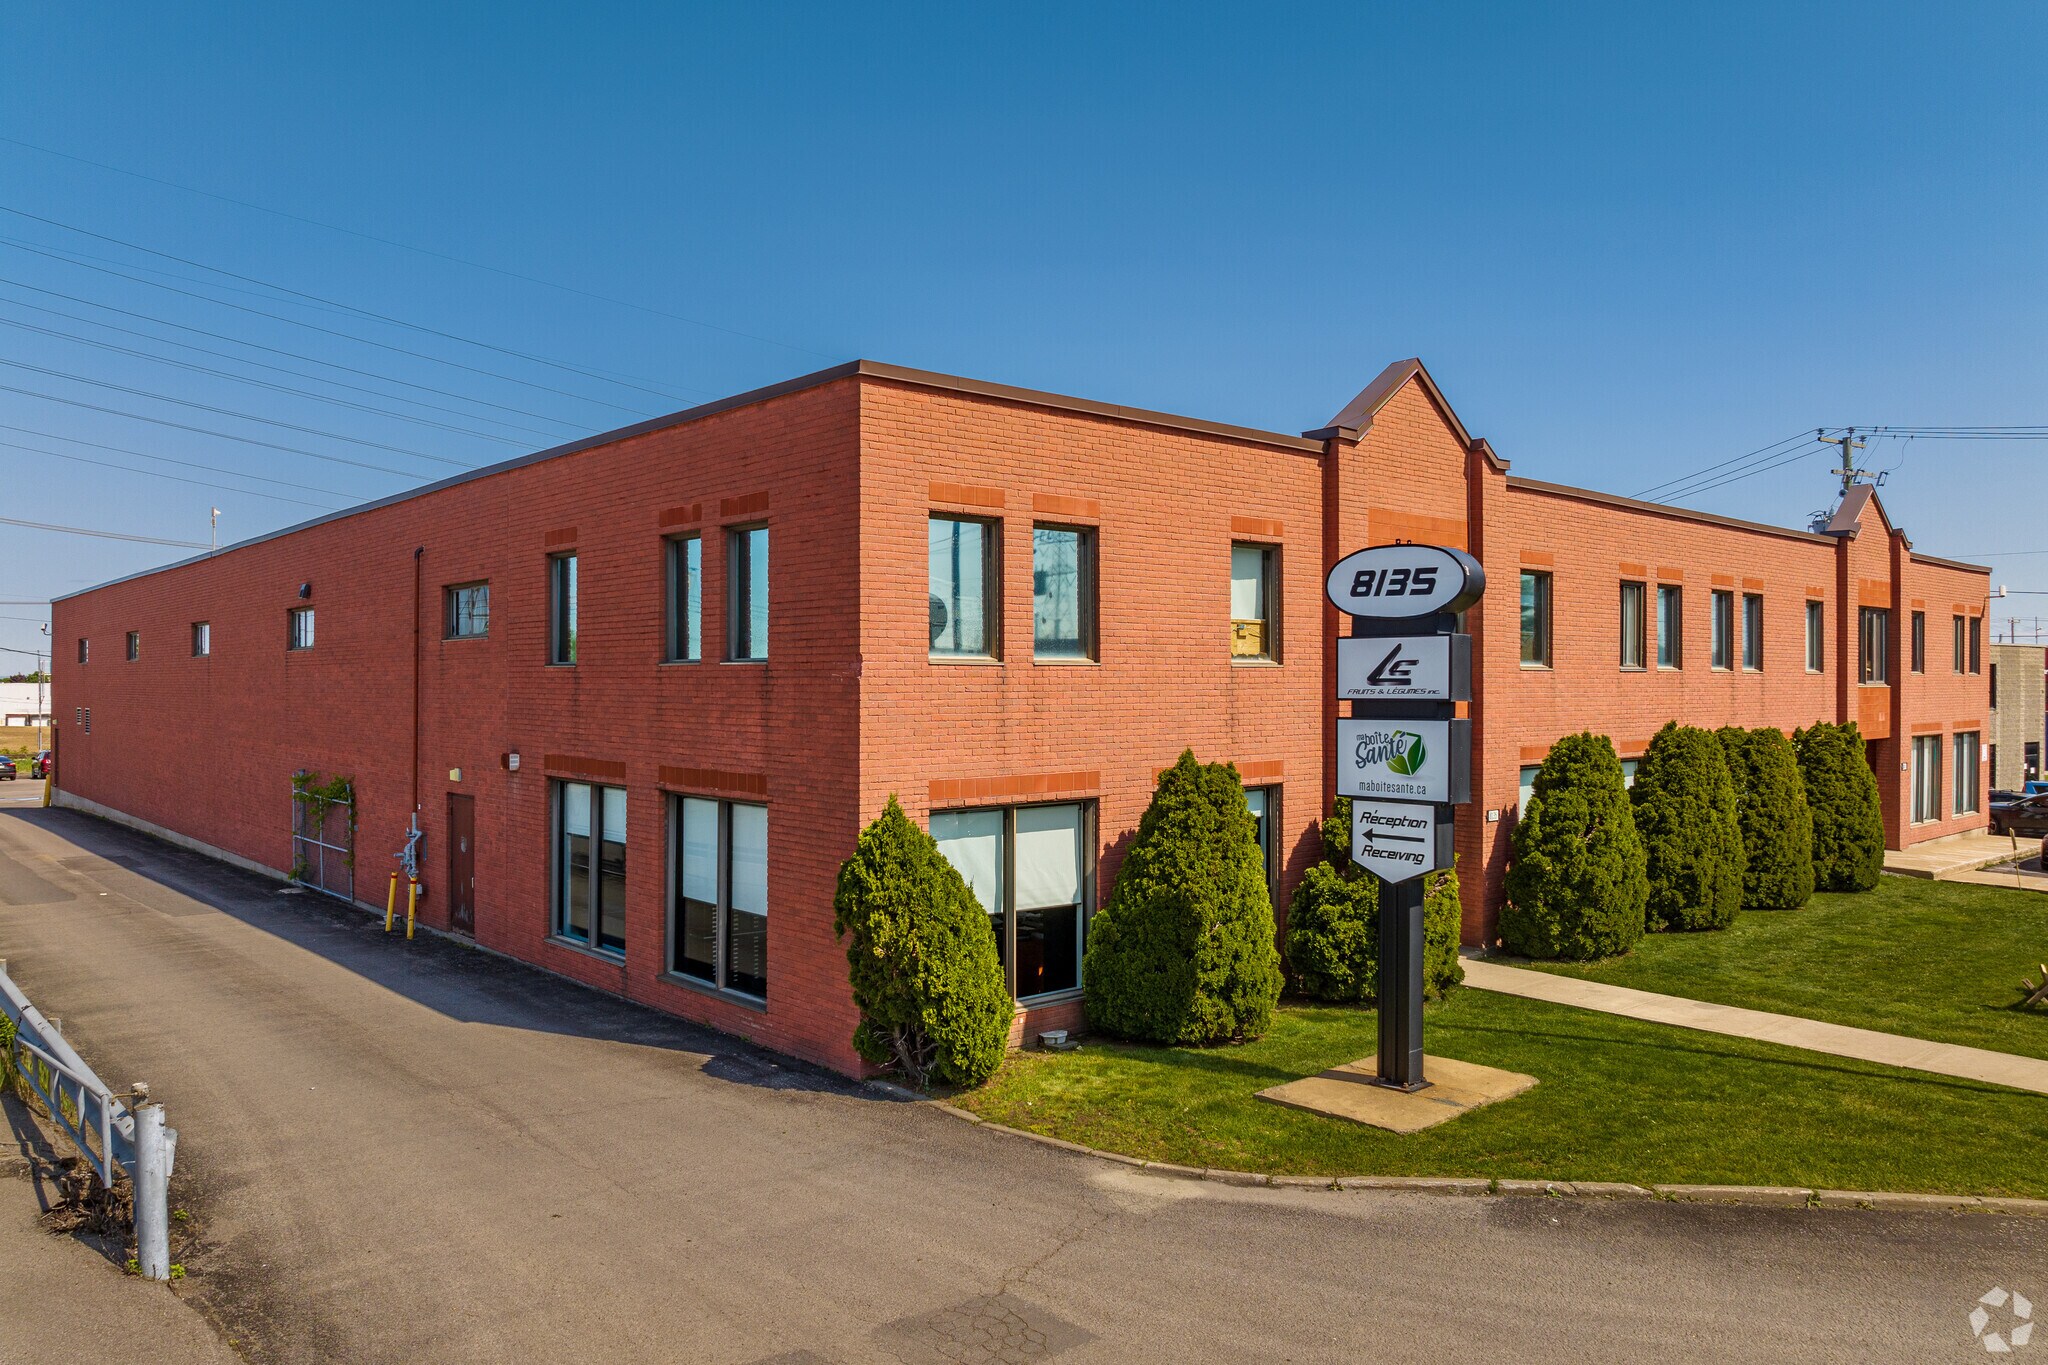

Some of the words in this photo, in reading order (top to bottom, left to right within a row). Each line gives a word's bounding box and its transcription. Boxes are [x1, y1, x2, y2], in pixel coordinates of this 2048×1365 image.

[1350, 567, 1439, 598] 8135
[1386, 686, 1427, 695] LÉGUMES
[1356, 733, 1365, 741] ma
[1364, 731, 1391, 746] boîte
[1355, 731, 1408, 769] Santé
[1359, 780, 1427, 795] maboitesante.ca
[1359, 810, 1428, 829] Réception
[1361, 845, 1425, 865] Receiving
